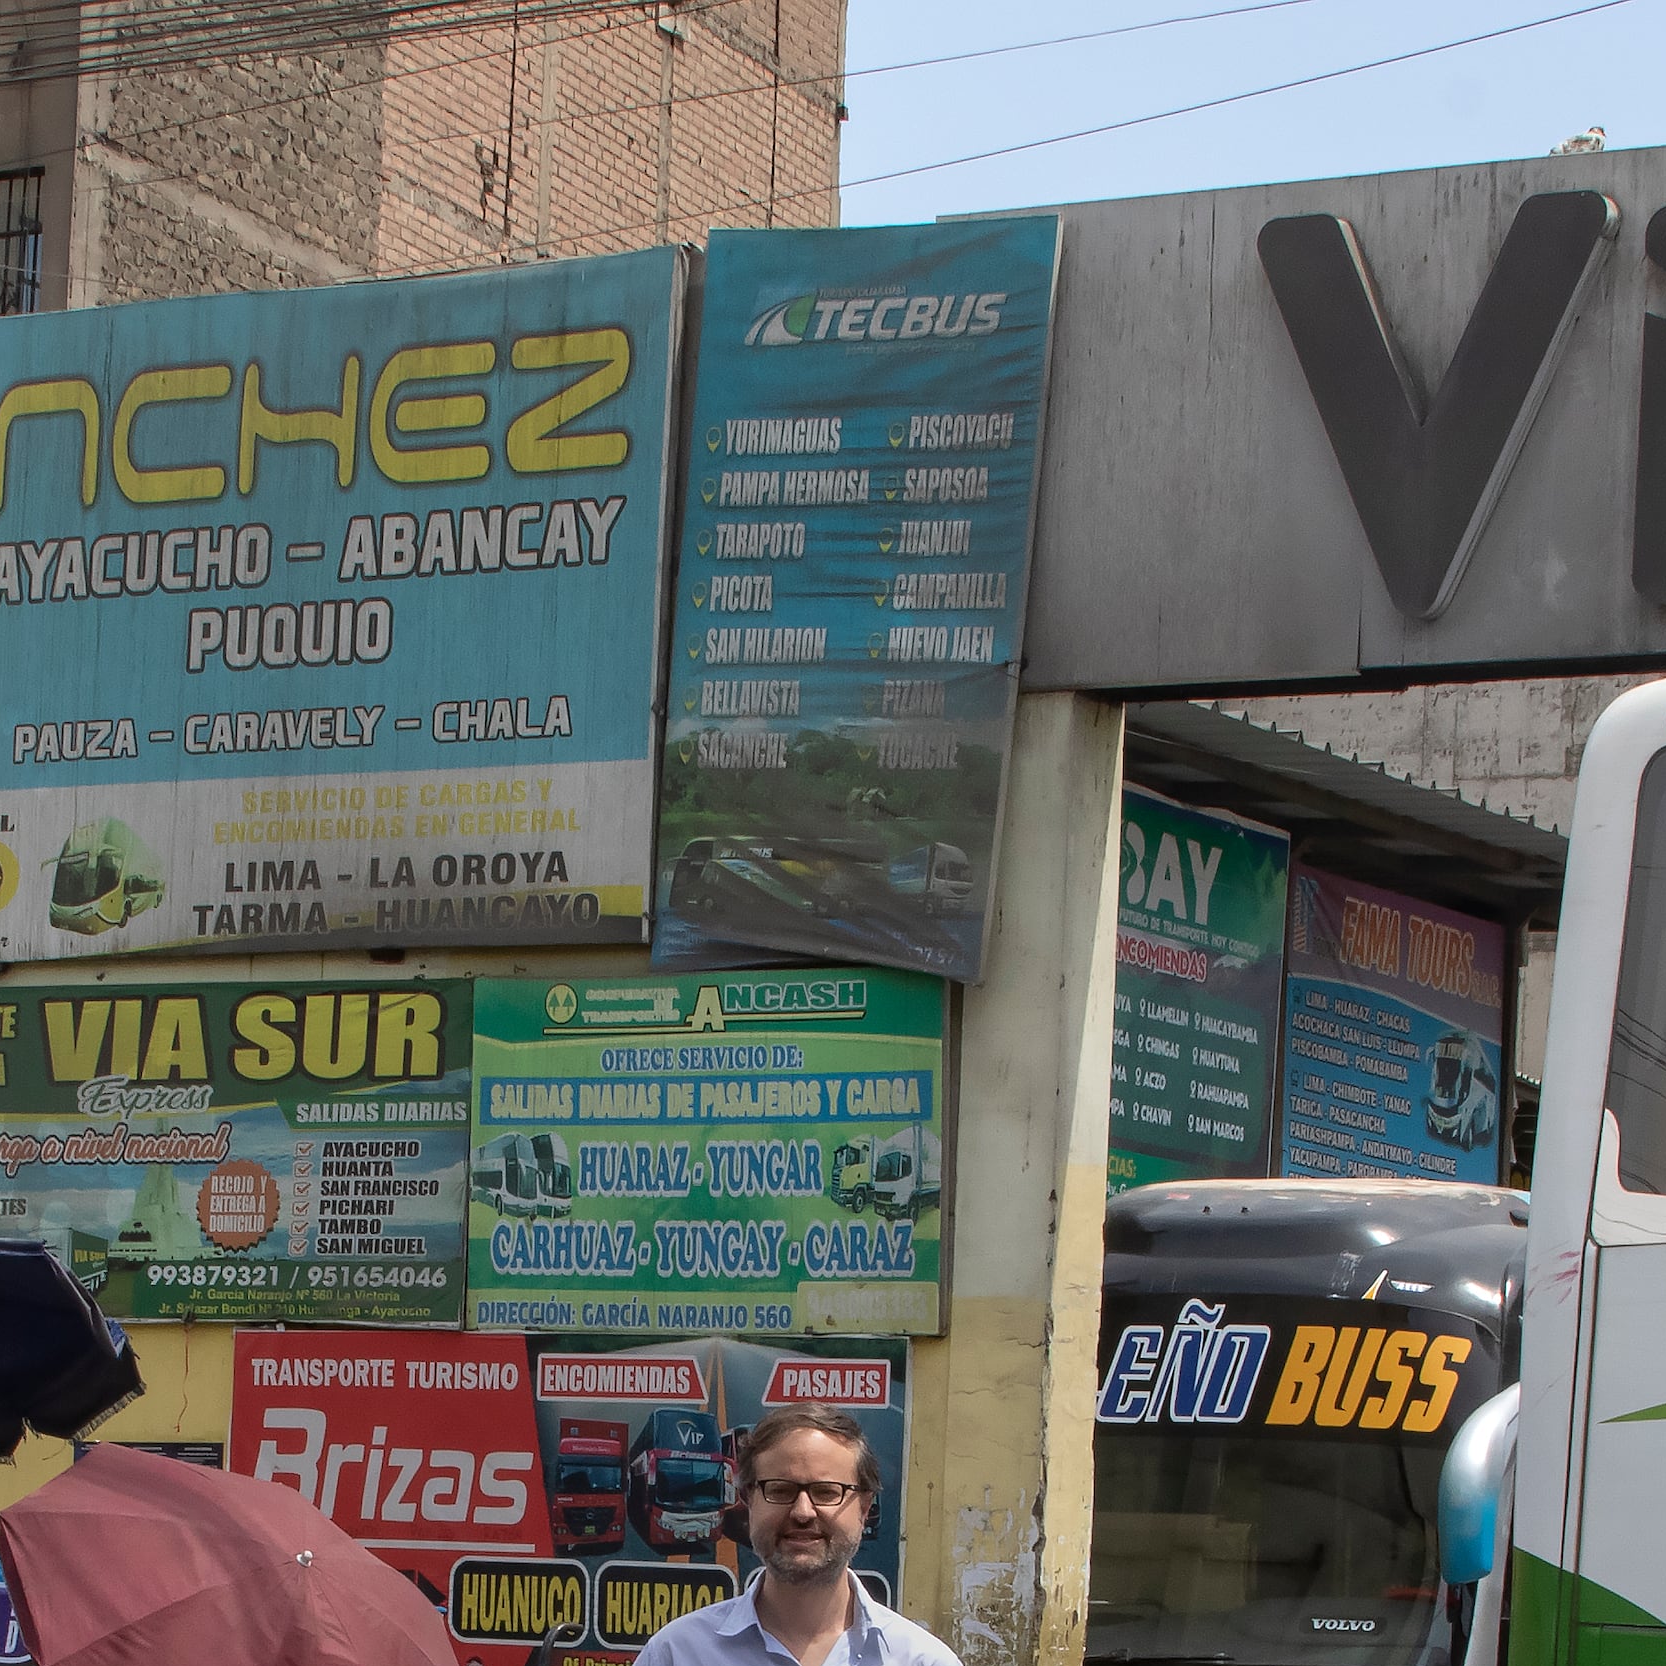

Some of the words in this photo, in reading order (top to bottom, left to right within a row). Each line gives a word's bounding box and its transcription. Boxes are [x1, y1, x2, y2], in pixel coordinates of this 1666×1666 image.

[813, 292, 1008, 341] TECBUS
[726, 418, 842, 456] YURIMAGUAS
[909, 414, 1015, 450] PISCOYACU
[719, 471, 779, 507] PAMPA
[784, 469, 871, 505] HERMOSA
[903, 467, 989, 501] SAPOSOA
[337, 496, 627, 583] ABANCAY
[716, 522, 807, 559] TARAPOTO
[897, 519, 972, 556] JUANJUI
[709, 575, 774, 612] PICOTA
[893, 573, 1007, 611] CAMPANILLA
[185, 597, 394, 673] PUQUIO
[705, 628, 740, 664] SAN
[743, 627, 827, 664] HILARION
[887, 627, 949, 663] NUEVO
[950, 626, 995, 663] JAEN
[701, 680, 801, 716] BELLAVISTA
[13, 719, 137, 764] PAUZA
[183, 705, 385, 755] CARAVELY
[432, 695, 573, 743] CHALA
[697, 732, 788, 769] SACANCHE
[878, 732, 958, 769] TOCACHE
[241, 784, 366, 815] SERVICIO
[375, 782, 410, 810] DE
[420, 779, 528, 808] CARGAS
[213, 811, 405, 846] ENCOMIENDAS
[414, 812, 454, 840] EN
[458, 808, 582, 835] GENERAL
[224, 858, 323, 893] LIMA
[369, 854, 416, 889] LA
[432, 850, 570, 887] OROYA
[192, 901, 331, 937] TARMA
[373, 891, 603, 934] HUANCAYO
[1340, 896, 1402, 979] FAMA
[1406, 914, 1475, 998] TOURS
[689, 979, 868, 1033] ANCASH
[1305, 990, 1328, 1011] LIMA
[1334, 999, 1371, 1024] HUARAZ
[1376, 1010, 1411, 1034] CHACAS
[43, 997, 210, 1081] VIA
[233, 992, 443, 1081] SUR
[1292, 1013, 1341, 1040] ACOCHACA
[600, 1045, 676, 1073] OFRECE
[677, 1044, 768, 1072] SERVICIO
[771, 1043, 804, 1070] DE:
[1145, 1035, 1181, 1060] CHINGAS
[1291, 1037, 1349, 1068] PISCOBAMBA
[76, 1073, 214, 1120] Express
[489, 1083, 575, 1119] SALIDAS
[578, 1082, 662, 1119] DIARIAS
[665, 1082, 695, 1118] DE
[699, 1079, 822, 1118] PASAJEROS
[824, 1078, 843, 1117] Y
[846, 1077, 921, 1115] CARGA
[1143, 1072, 1167, 1091] ACZO
[1331, 1080, 1378, 1107] CHIMBOTE
[296, 1102, 380, 1123] SALIDAS
[384, 1101, 468, 1121] DIARIAS
[1140, 1104, 1173, 1127] CHAVIN
[1213, 1121, 1246, 1143] MARCOS
[1290, 1094, 1324, 1120] TARICA
[1328, 1105, 1387, 1136] PASACANCHA
[124, 1122, 232, 1164] nacional
[322, 1141, 421, 1158] AYACUCHO
[1289, 1120, 1356, 1153] PARIASHPAMPA
[1361, 1139, 1414, 1167] ANDAYMAYO
[1418, 1154, 1458, 1177] CILINDRE
[1289, 1146, 1342, 1175] YACUPAMPA
[211, 1175, 254, 1193] RECOJO
[321, 1161, 394, 1178] HUANTA
[577, 1140, 692, 1198] HUARAZ
[705, 1139, 824, 1198] YUNGAR
[209, 1194, 255, 1214] ENTREGA
[320, 1180, 352, 1197] SAN
[354, 1180, 440, 1197] FRANCISCO
[208, 1213, 266, 1234] DOMICILIO
[318, 1200, 396, 1217] PICHARI
[318, 1218, 383, 1236] TAMBO
[316, 1239, 356, 1256] SAN
[357, 1237, 427, 1256] MIGUEL
[490, 1220, 637, 1277] CARHUAZ
[654, 1219, 787, 1278] YUNGAY
[804, 1219, 917, 1278] CARAZ
[147, 1265, 280, 1288] 993879321
[307, 1265, 448, 1289] 951654046
[477, 1297, 577, 1325] DIRECCIÓN:
[581, 1296, 651, 1327] GARCÍA
[657, 1304, 748, 1329] NARANJO
[753, 1304, 792, 1329] 560
[251, 1358, 395, 1387] TRANSPORTE
[405, 1361, 519, 1391] TURISMO
[543, 1363, 691, 1395] ENCOMIENDAS
[782, 1368, 882, 1399] PASAJES
[1264, 1325, 1472, 1433] BUSS
[254, 1407, 534, 1525] Brizas
[460, 1573, 582, 1634] HUANUCO
[1311, 1618, 1376, 1632] VOLVO
